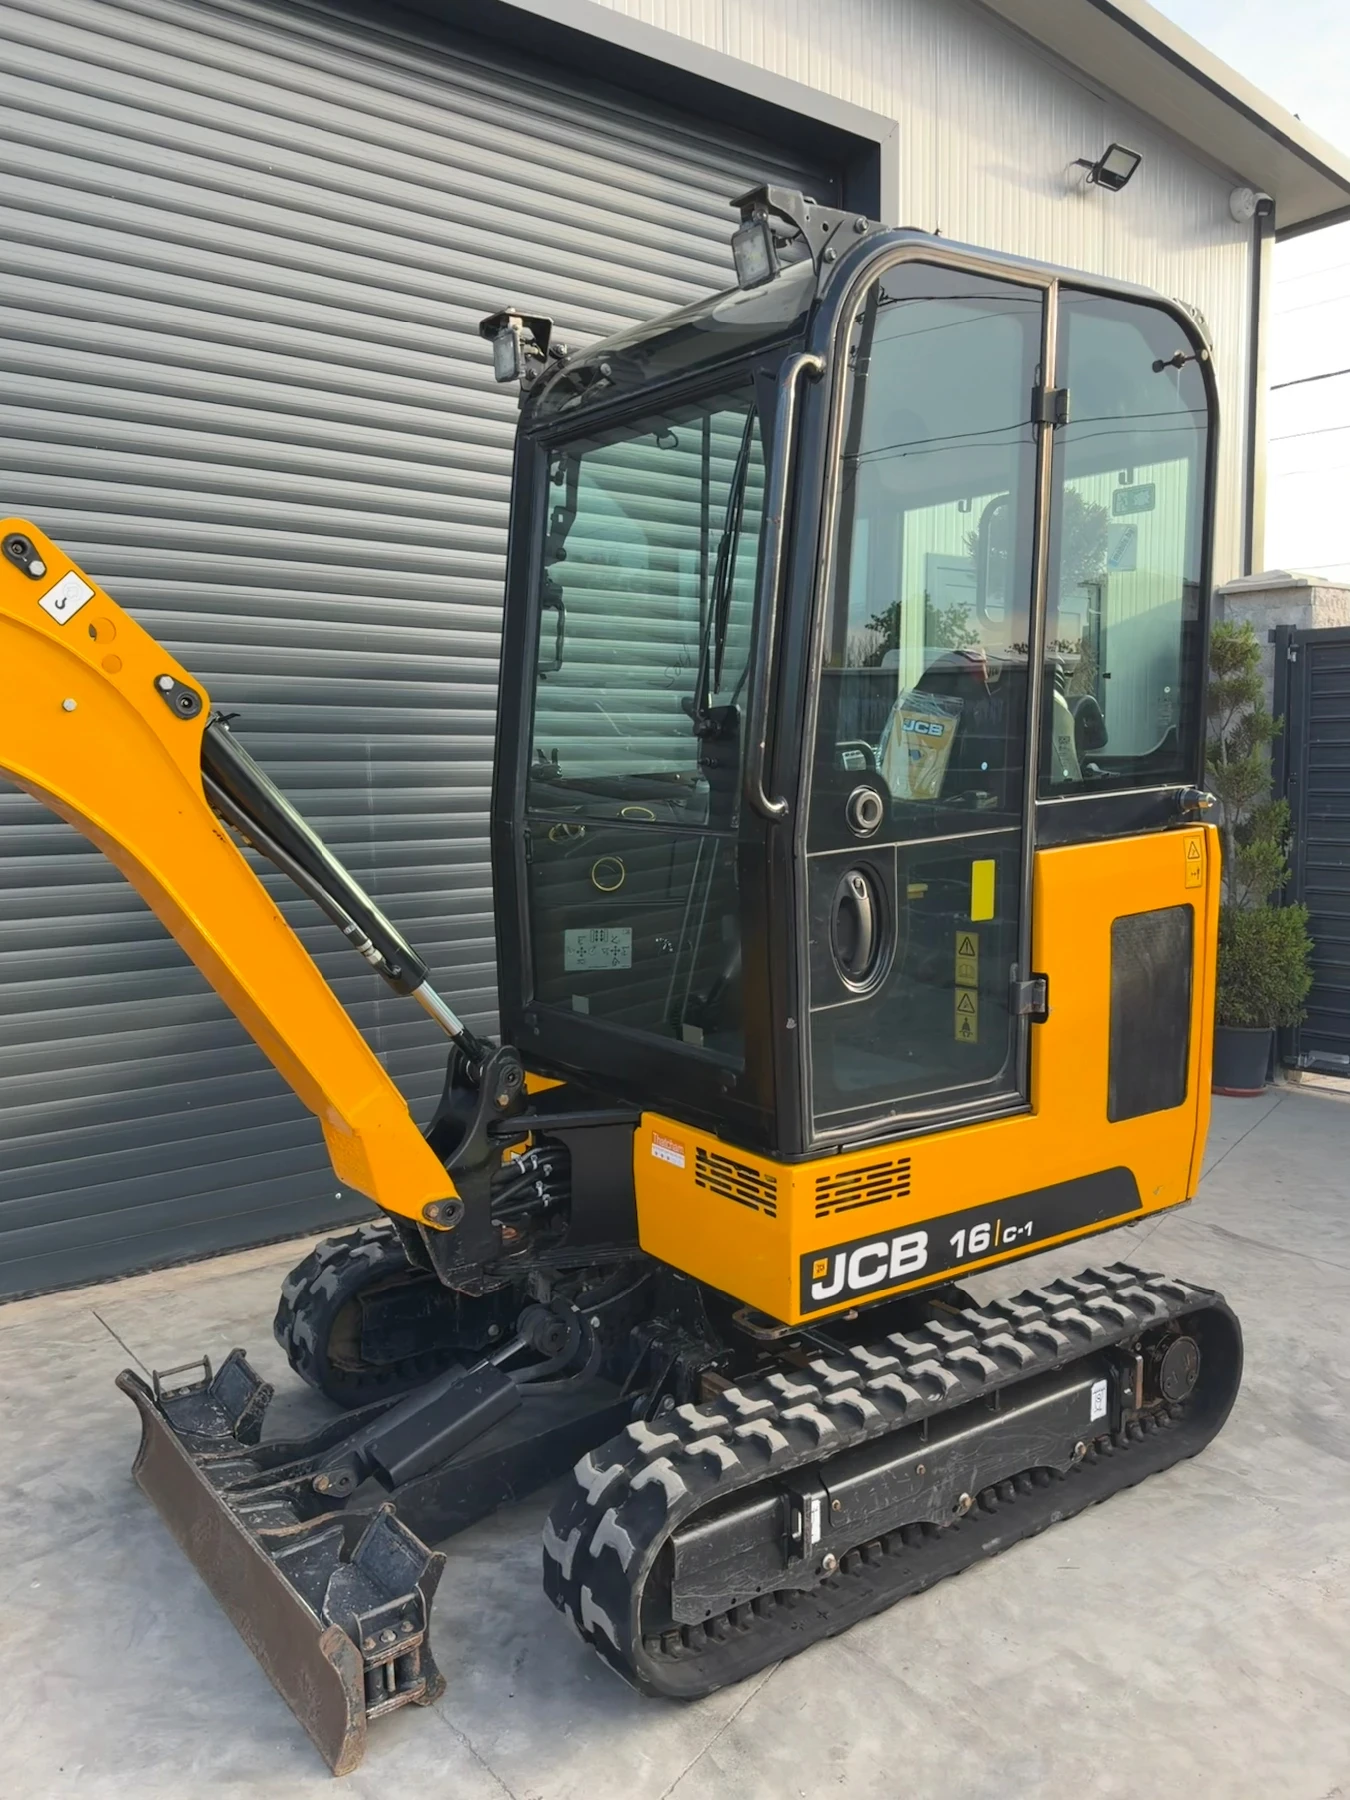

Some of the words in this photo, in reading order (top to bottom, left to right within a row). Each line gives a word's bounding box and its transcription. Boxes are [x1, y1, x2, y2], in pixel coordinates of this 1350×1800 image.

[903, 719, 943, 736] JCB
[811, 1231, 928, 1300] JCB
[950, 1222, 991, 1258] 16
